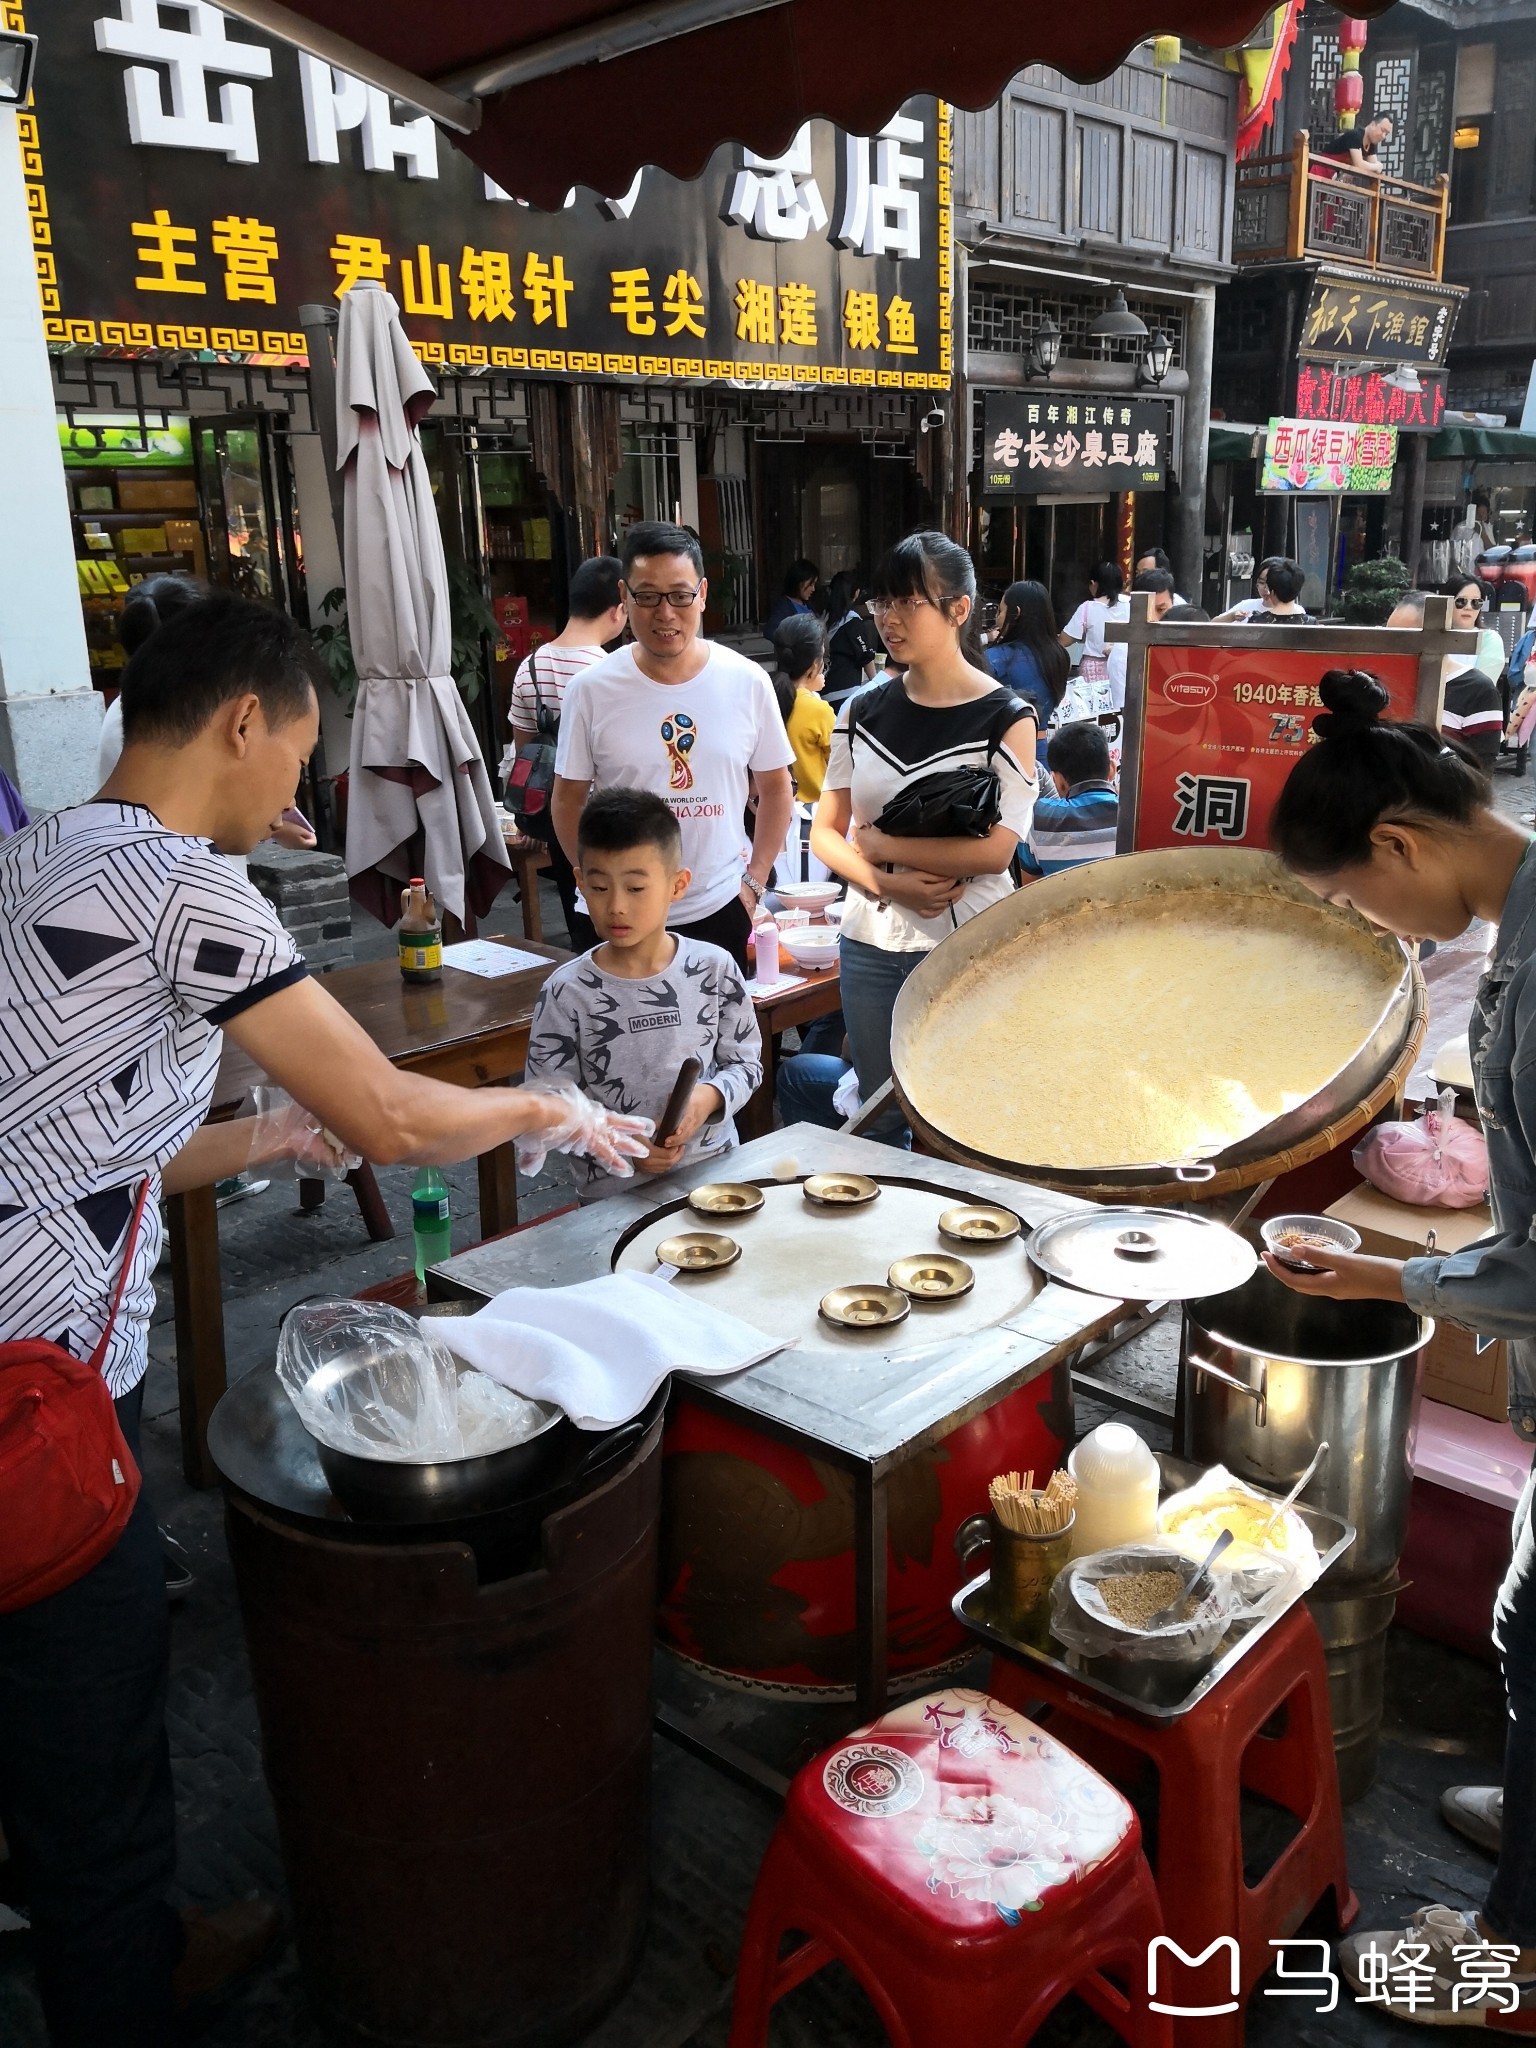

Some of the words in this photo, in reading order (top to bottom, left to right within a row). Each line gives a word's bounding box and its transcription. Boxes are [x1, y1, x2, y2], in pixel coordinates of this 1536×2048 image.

[131, 210, 279, 304] 主营
[329, 234, 574, 328] 君山银针
[610, 268, 707, 339] 毛尖
[734, 279, 819, 347] 湘莲
[844, 289, 919, 355] 银鱼
[1027, 404, 1132, 426] 百年湘江传奇
[993, 427, 1160, 469] 老长沙臭豆腐
[693, 804, 725, 818] 2018
[1172, 772, 1251, 840] 洞
[632, 1014, 678, 1029] MODERN
